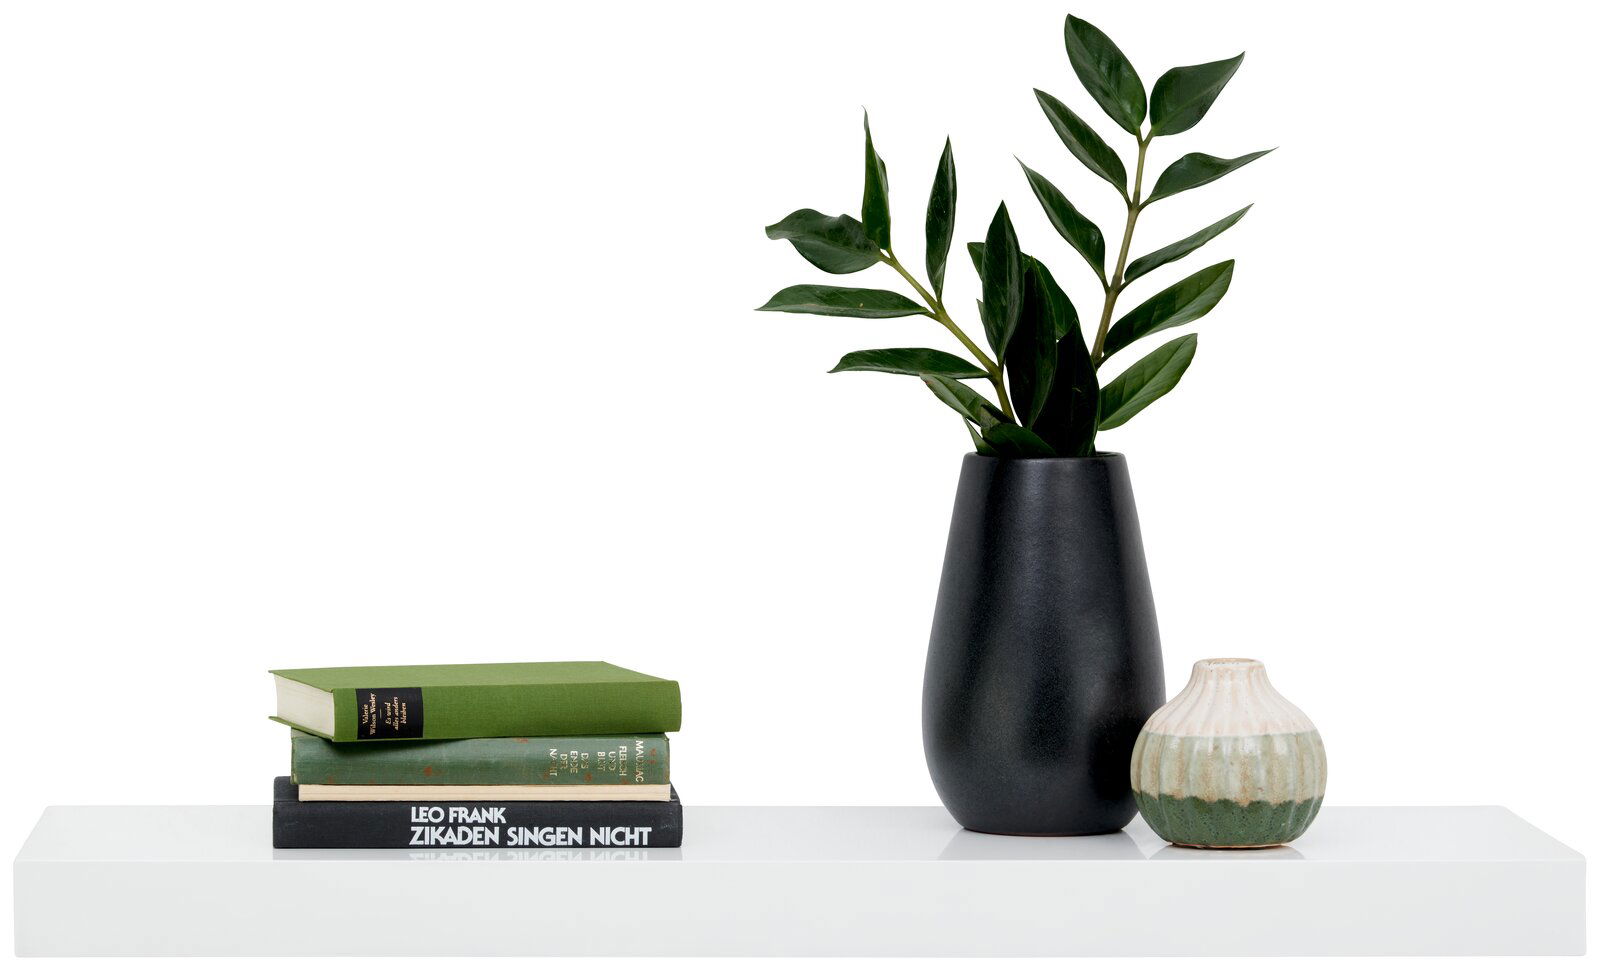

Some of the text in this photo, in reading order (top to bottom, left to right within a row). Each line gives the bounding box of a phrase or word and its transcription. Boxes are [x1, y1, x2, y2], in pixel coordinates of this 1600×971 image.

[368, 692, 377, 736] Wilson Wesley
[384, 702, 392, 725] Es wird
[570, 750, 578, 774] ENDE
[411, 806, 507, 824] LEO FRANK
[409, 826, 652, 846] ZIKADEN SINGEN NICHT
